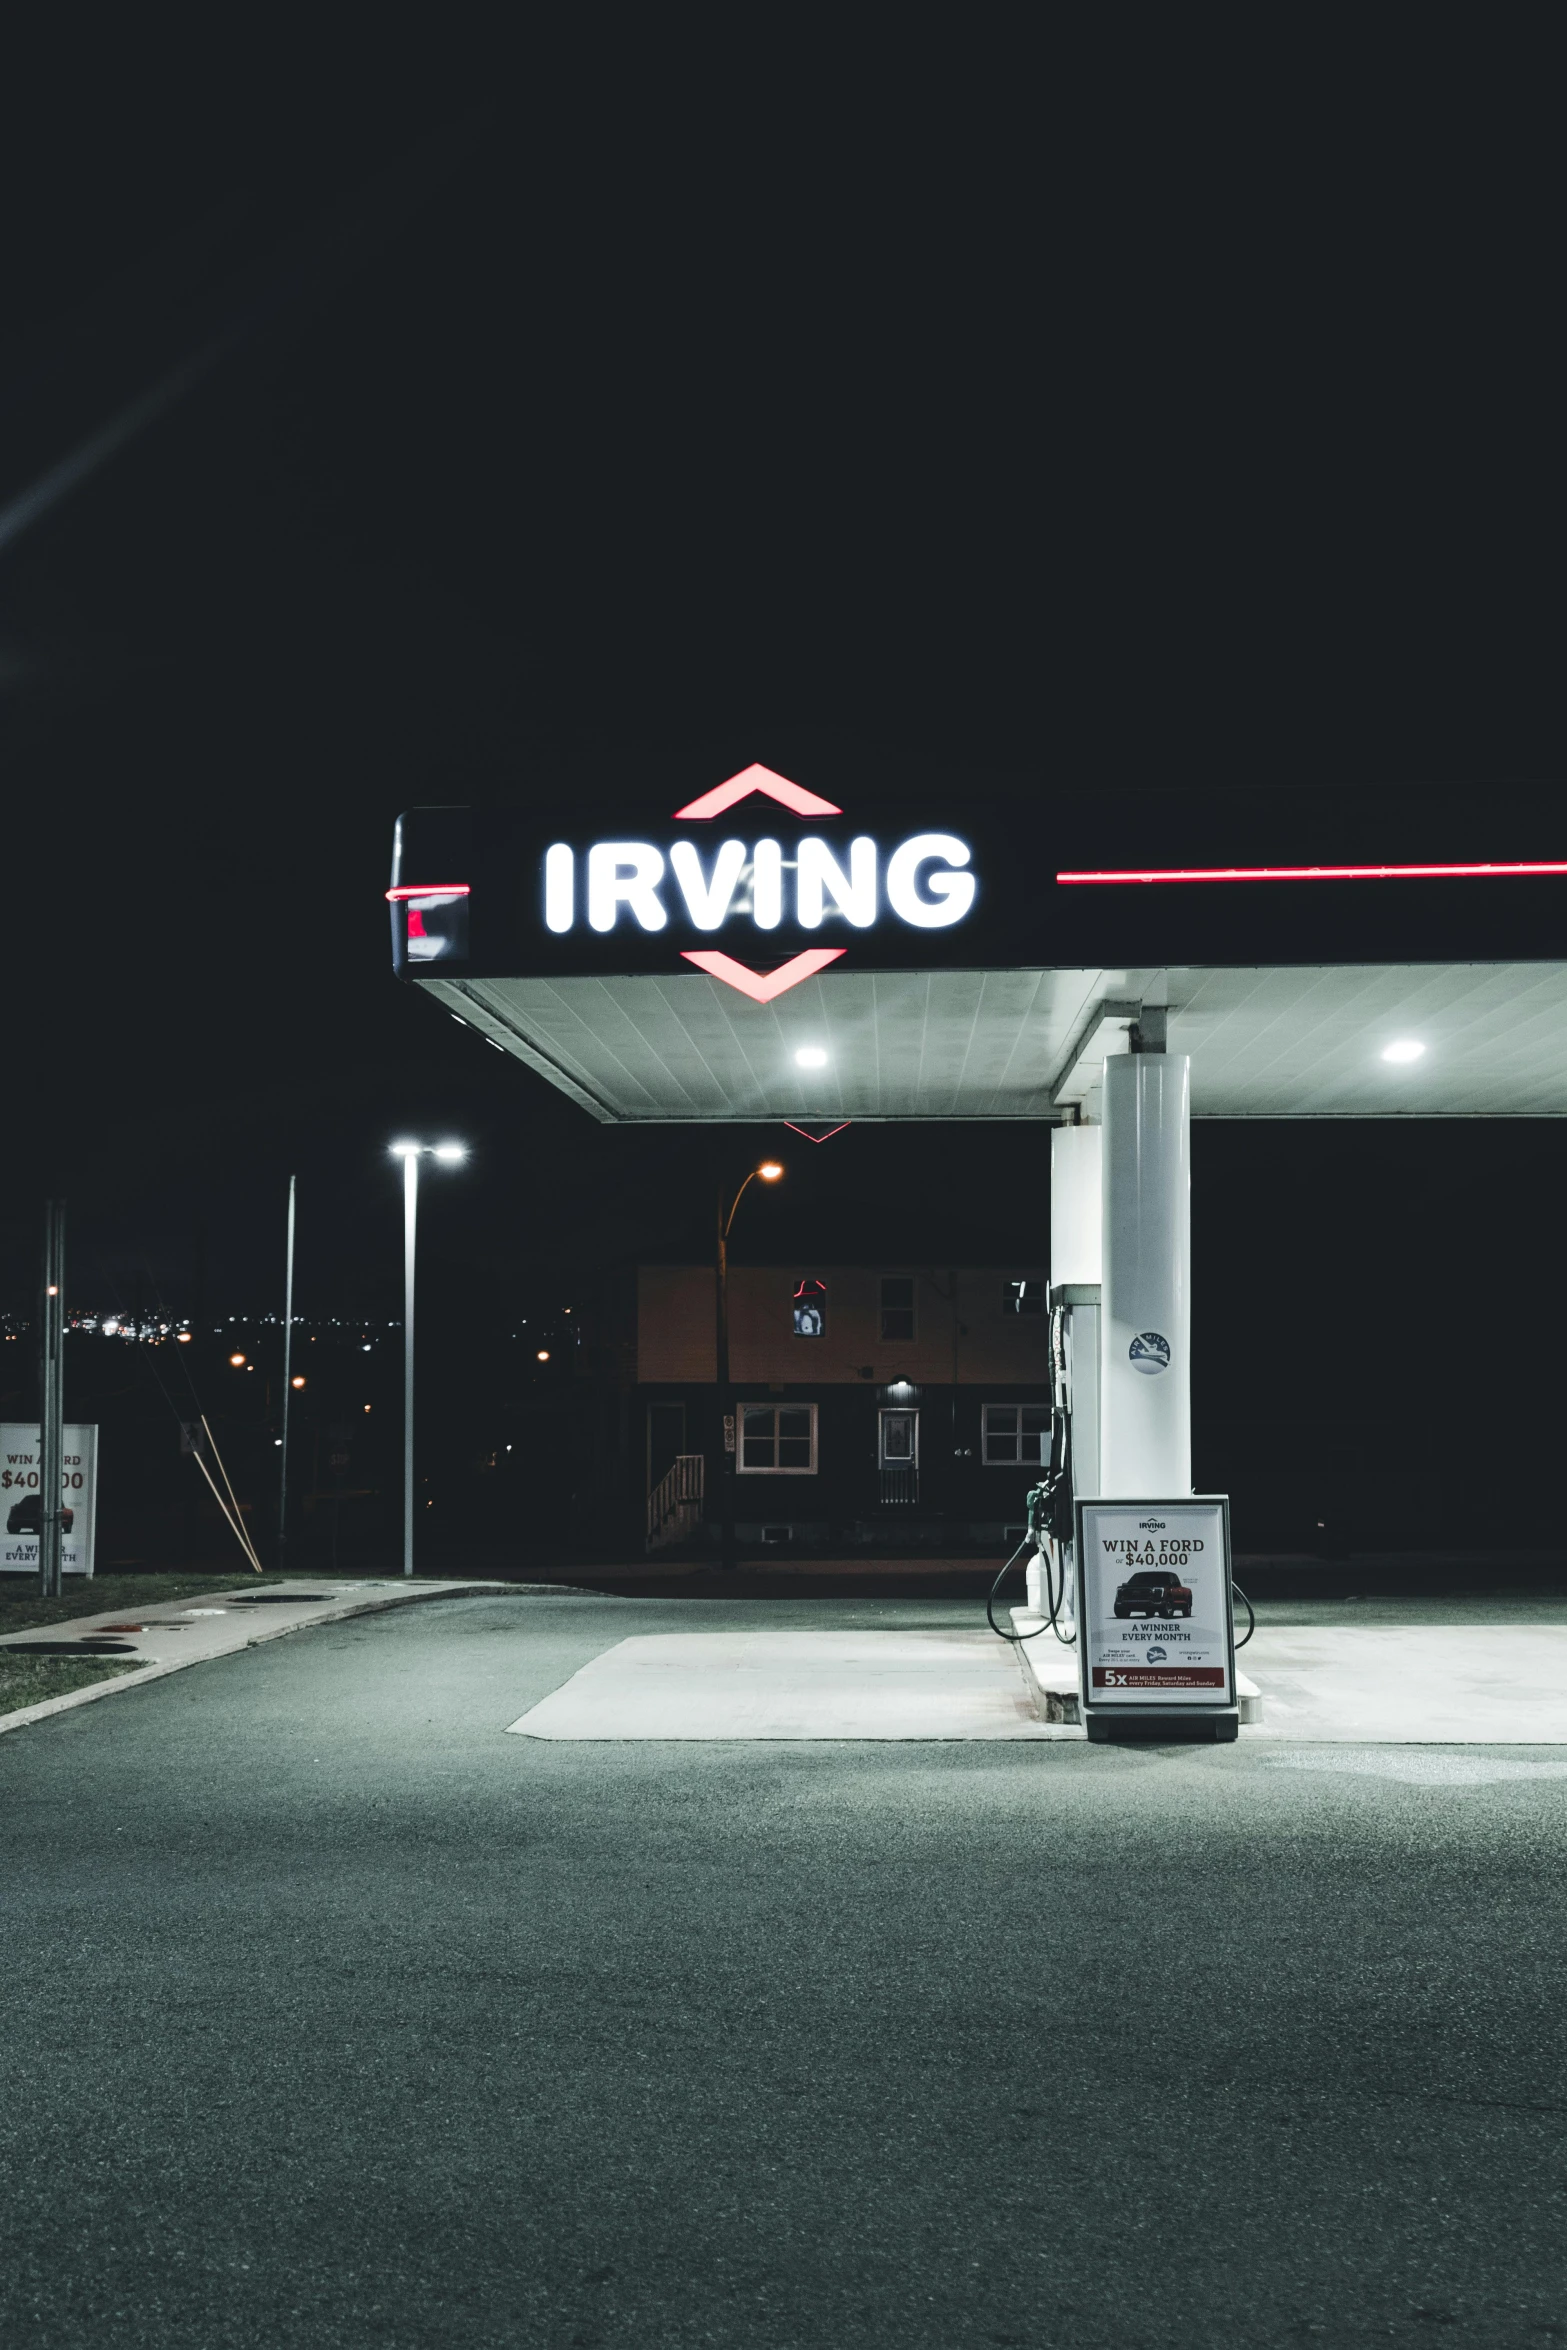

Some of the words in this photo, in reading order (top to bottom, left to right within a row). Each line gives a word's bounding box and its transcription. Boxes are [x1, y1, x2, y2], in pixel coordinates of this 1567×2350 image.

[546, 834, 975, 932] IRVING
[1130, 1340, 1140, 1356] AIR
[1146, 1335, 1168, 1351] MILES
[6, 1454, 33, 1465] WIN
[1, 1469, 84, 1490] $4000
[16, 1544, 23, 1553] A
[1102, 1540, 1139, 1552] WIN
[1144, 1540, 1155, 1552] A
[1160, 1540, 1204, 1552] FORD
[5, 1552, 37, 1561] EVERY
[1131, 1624, 1139, 1632] A
[1140, 1624, 1181, 1632] WINNER
[1122, 1633, 1152, 1641] EVERY
[1154, 1633, 1191, 1641] MONTH
[1105, 1670, 1127, 1686] 5x
